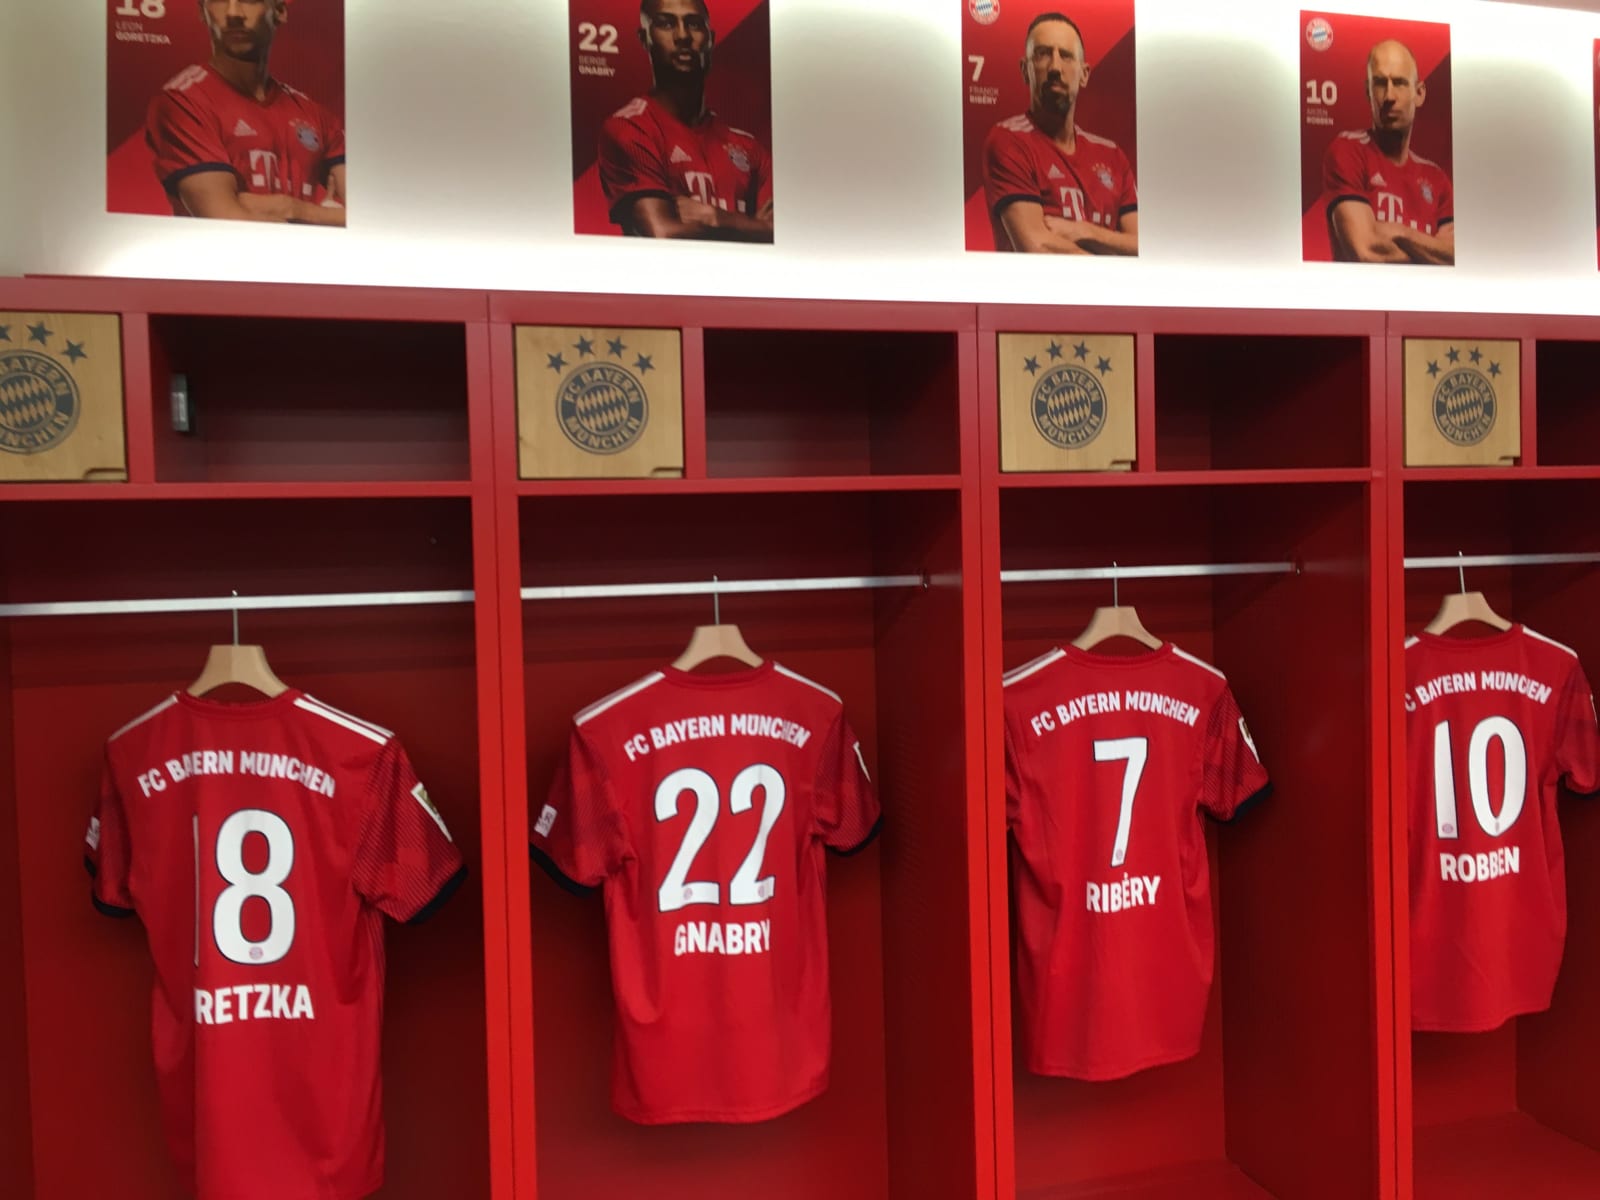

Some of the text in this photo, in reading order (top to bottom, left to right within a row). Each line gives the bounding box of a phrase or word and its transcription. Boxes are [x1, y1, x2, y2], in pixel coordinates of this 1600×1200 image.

[578, 22, 619, 53] 22
[968, 55, 985, 82] 7
[1306, 79, 1338, 106] 10
[564, 368, 641, 404] FC BAYERN
[1050, 370, 1101, 403] BAYERN
[1415, 672, 1477, 706] BAYERN
[1481, 670, 1552, 705] MÜNCEN
[1030, 690, 1200, 737] FC BAYERN MÜNCHEN
[623, 713, 811, 762] FC BAYERN MÜNCHEN
[137, 750, 336, 799] FC BAERN MÜNCHEN
[1434, 715, 1527, 840] 10
[1093, 736, 1149, 868] 7
[654, 762, 786, 913] 22
[1439, 846, 1521, 884] ROBBEN
[193, 807, 297, 967] 8
[1086, 871, 1161, 914] RIBÉRY
[674, 918, 771, 957] GNABRY
[193, 984, 315, 1025] RETZKA
